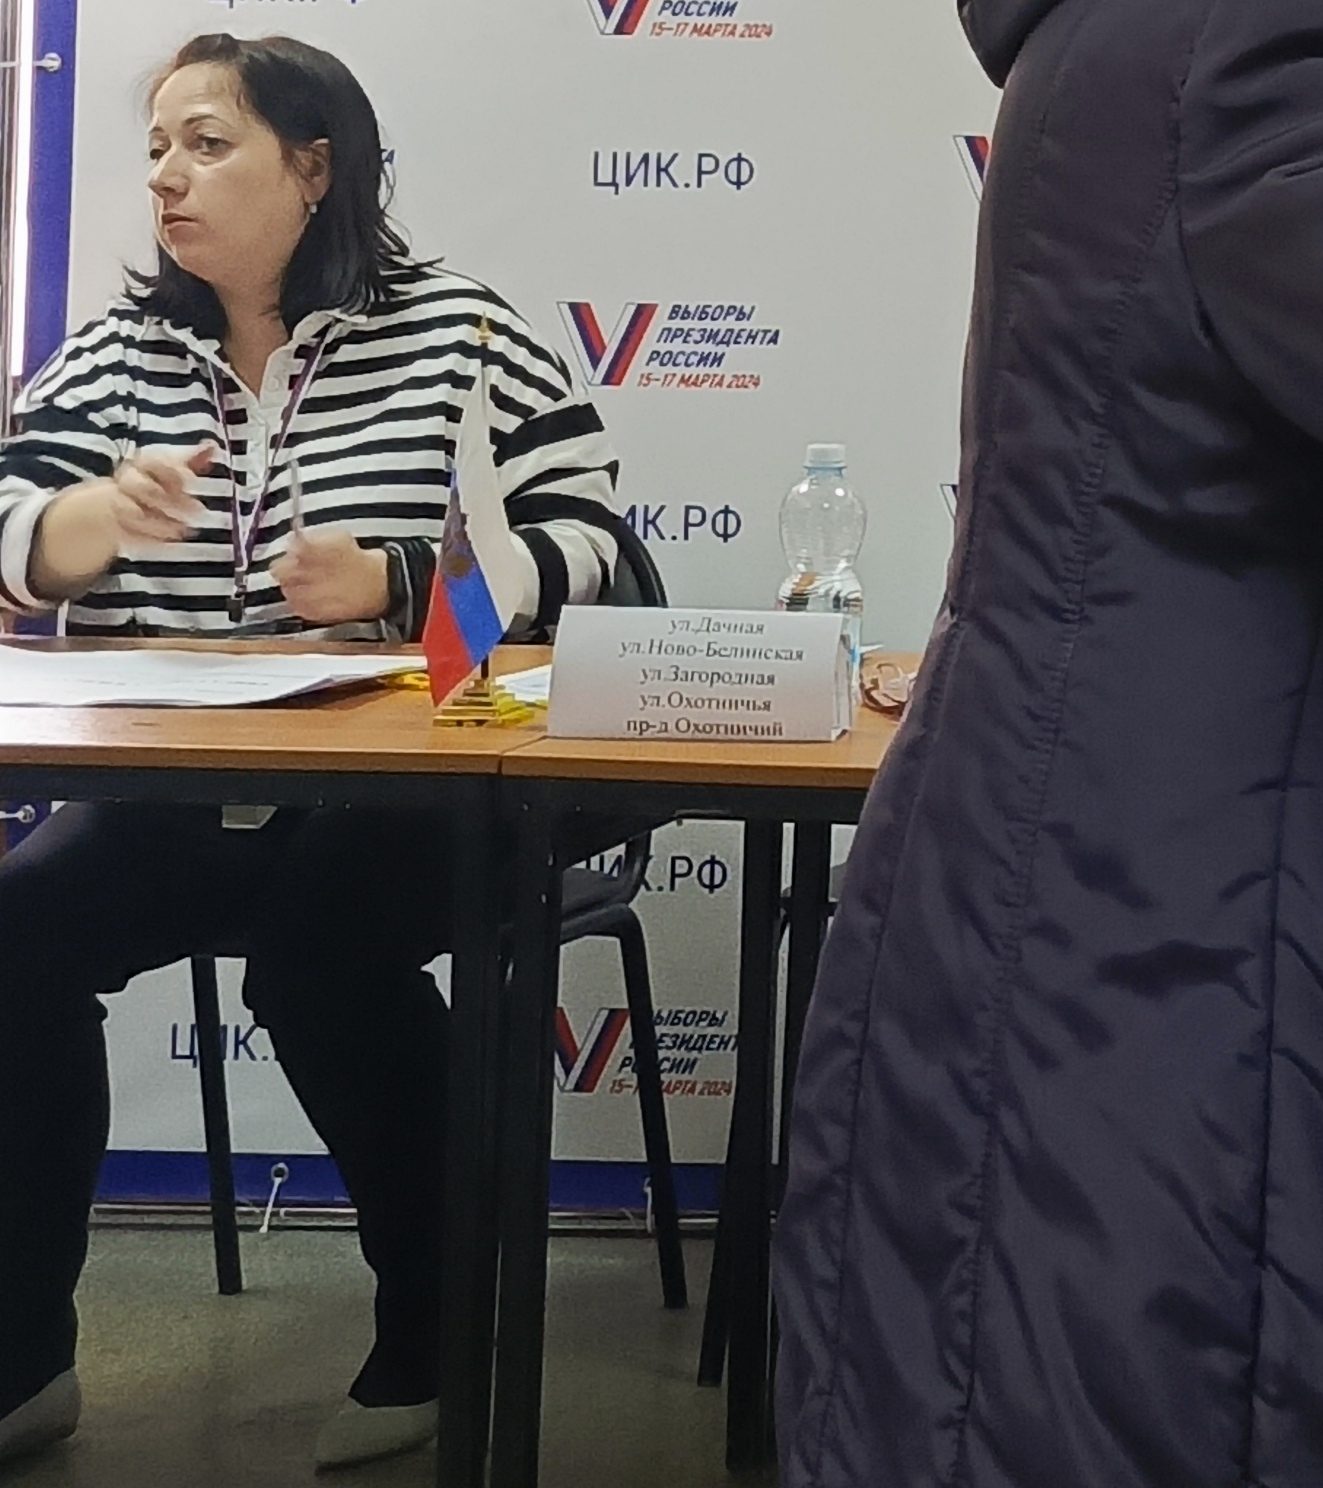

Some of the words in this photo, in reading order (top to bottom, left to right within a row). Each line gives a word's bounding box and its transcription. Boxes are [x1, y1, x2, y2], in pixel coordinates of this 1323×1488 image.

[658, 0, 738, 17] РОССИИ
[689, 23, 737, 37] МАРТА
[739, 23, 772, 38] 2024
[593, 151, 754, 195] ЦИК.РФ
[667, 304, 755, 321] ВЫБОРЫ
[656, 327, 780, 347] ПРЕЗИДЕНТА
[645, 350, 725, 368] РОССИИ
[677, 373, 725, 388] МАРТА
[726, 374, 760, 388] 2024
[625, 504, 742, 543] ИК.РФ
[626, 719, 669, 736] пр-д
[675, 717, 783, 737] Охотничий
[652, 1010, 728, 1028] ЫБОРЫ
[660, 1079, 697, 1096] АРТА
[698, 1079, 733, 1096] 2024
